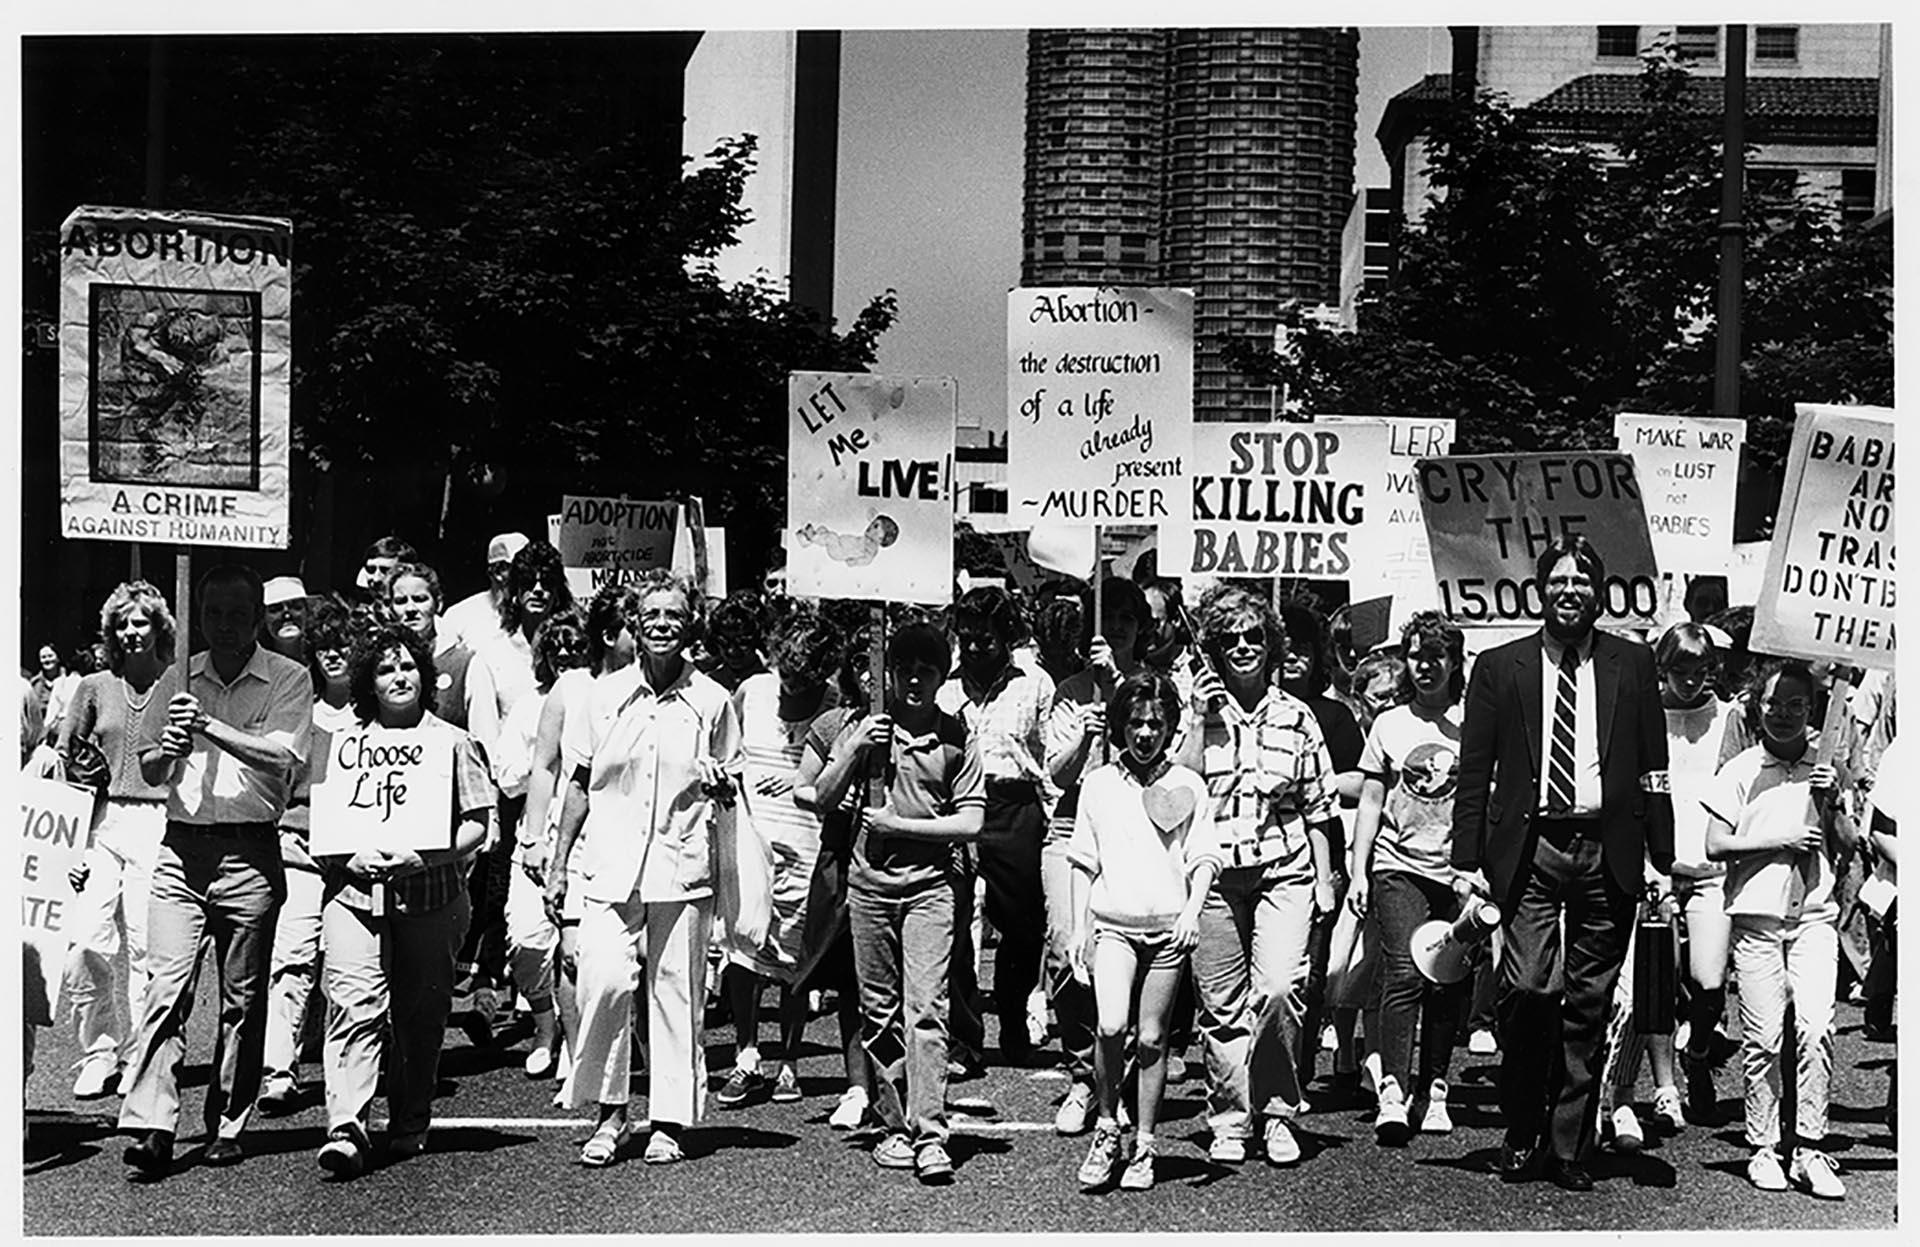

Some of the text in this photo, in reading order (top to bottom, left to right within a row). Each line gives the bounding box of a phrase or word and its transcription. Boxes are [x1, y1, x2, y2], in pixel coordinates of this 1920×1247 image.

[64, 224, 290, 268] ABORTION
[1019, 352, 1160, 374] the destruction
[797, 382, 846, 434] LET
[1020, 389, 1114, 424] of a life
[828, 428, 870, 466] Me
[1080, 414, 1152, 459] already
[1230, 432, 1339, 475] STOP
[1391, 425, 1444, 456] LER
[1636, 428, 1733, 451] MAKE WAR
[858, 453, 952, 501] LIVE!
[1111, 457, 1182, 487] present
[1419, 458, 1639, 504] CRY FOR
[1675, 462, 1716, 479] LUST
[1849, 470, 1895, 503] AR
[112, 490, 237, 518] A CRIME
[565, 500, 674, 531] ADOPTION
[1193, 476, 1363, 525] KILLING
[1843, 499, 1891, 533] NO
[68, 516, 280, 545] AGAINST HUMANITY
[592, 536, 615, 548] not
[1485, 515, 1587, 559] THE
[1651, 515, 1711, 537] BABIES
[1191, 529, 1350, 574] BABIES
[338, 734, 423, 770] Choose
[348, 770, 407, 822] Life
[21, 805, 79, 848] ION
[21, 896, 63, 932] TE
